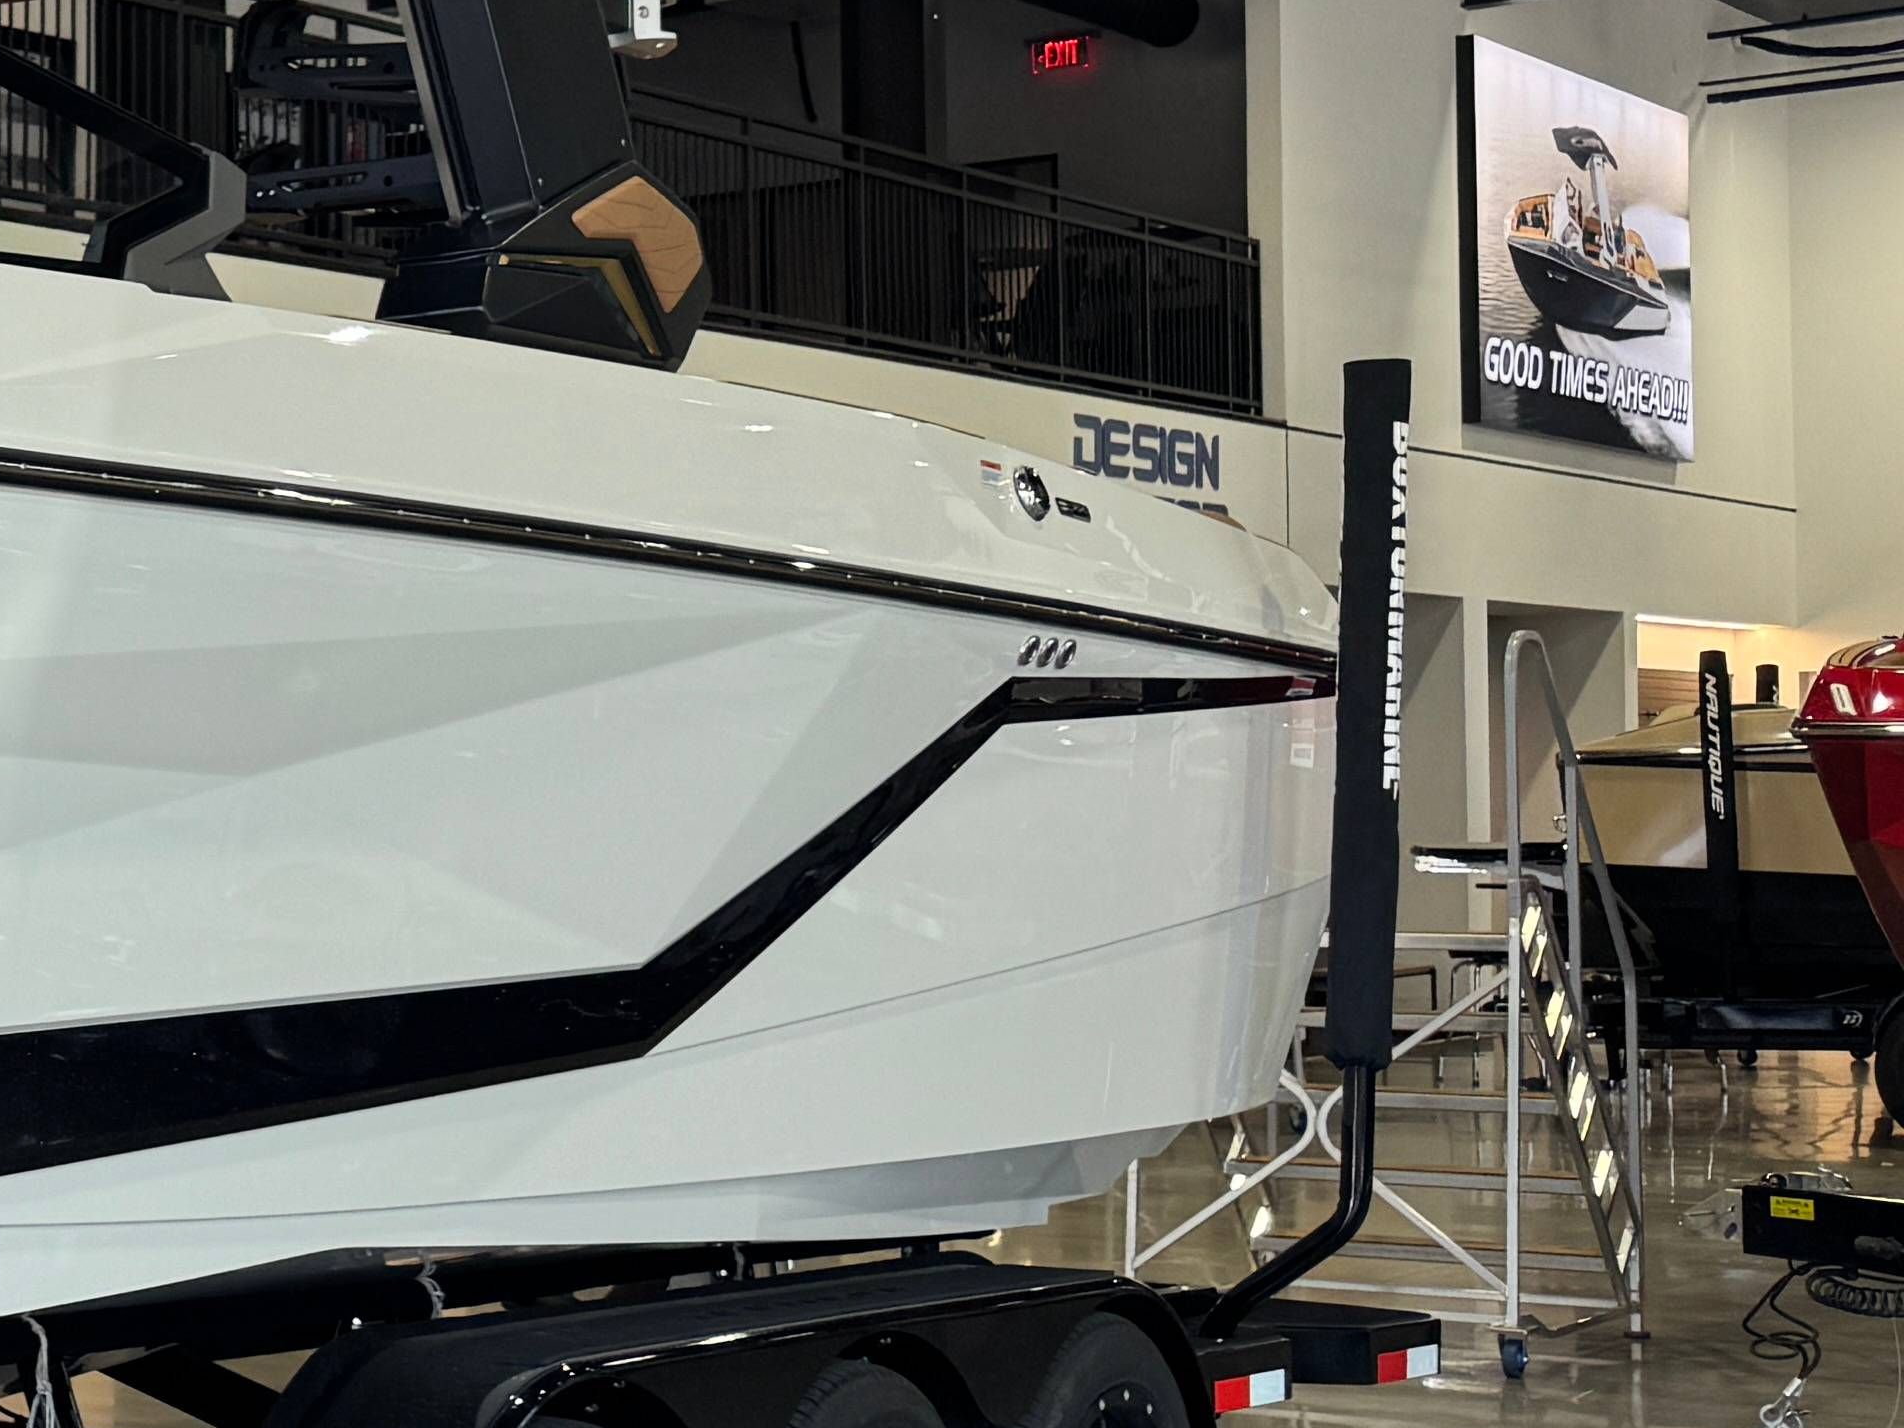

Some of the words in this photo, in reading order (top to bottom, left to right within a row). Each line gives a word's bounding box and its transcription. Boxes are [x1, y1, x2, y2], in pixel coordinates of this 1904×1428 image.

[1044, 39, 1078, 69] EXIT
[1484, 336, 1544, 391] GOOD
[1549, 350, 1609, 404] TIMES
[1612, 366, 1690, 423] AHEAD!!!
[1073, 413, 1220, 492] DESIGN
[1704, 672, 1725, 818] NAUTIQUE
